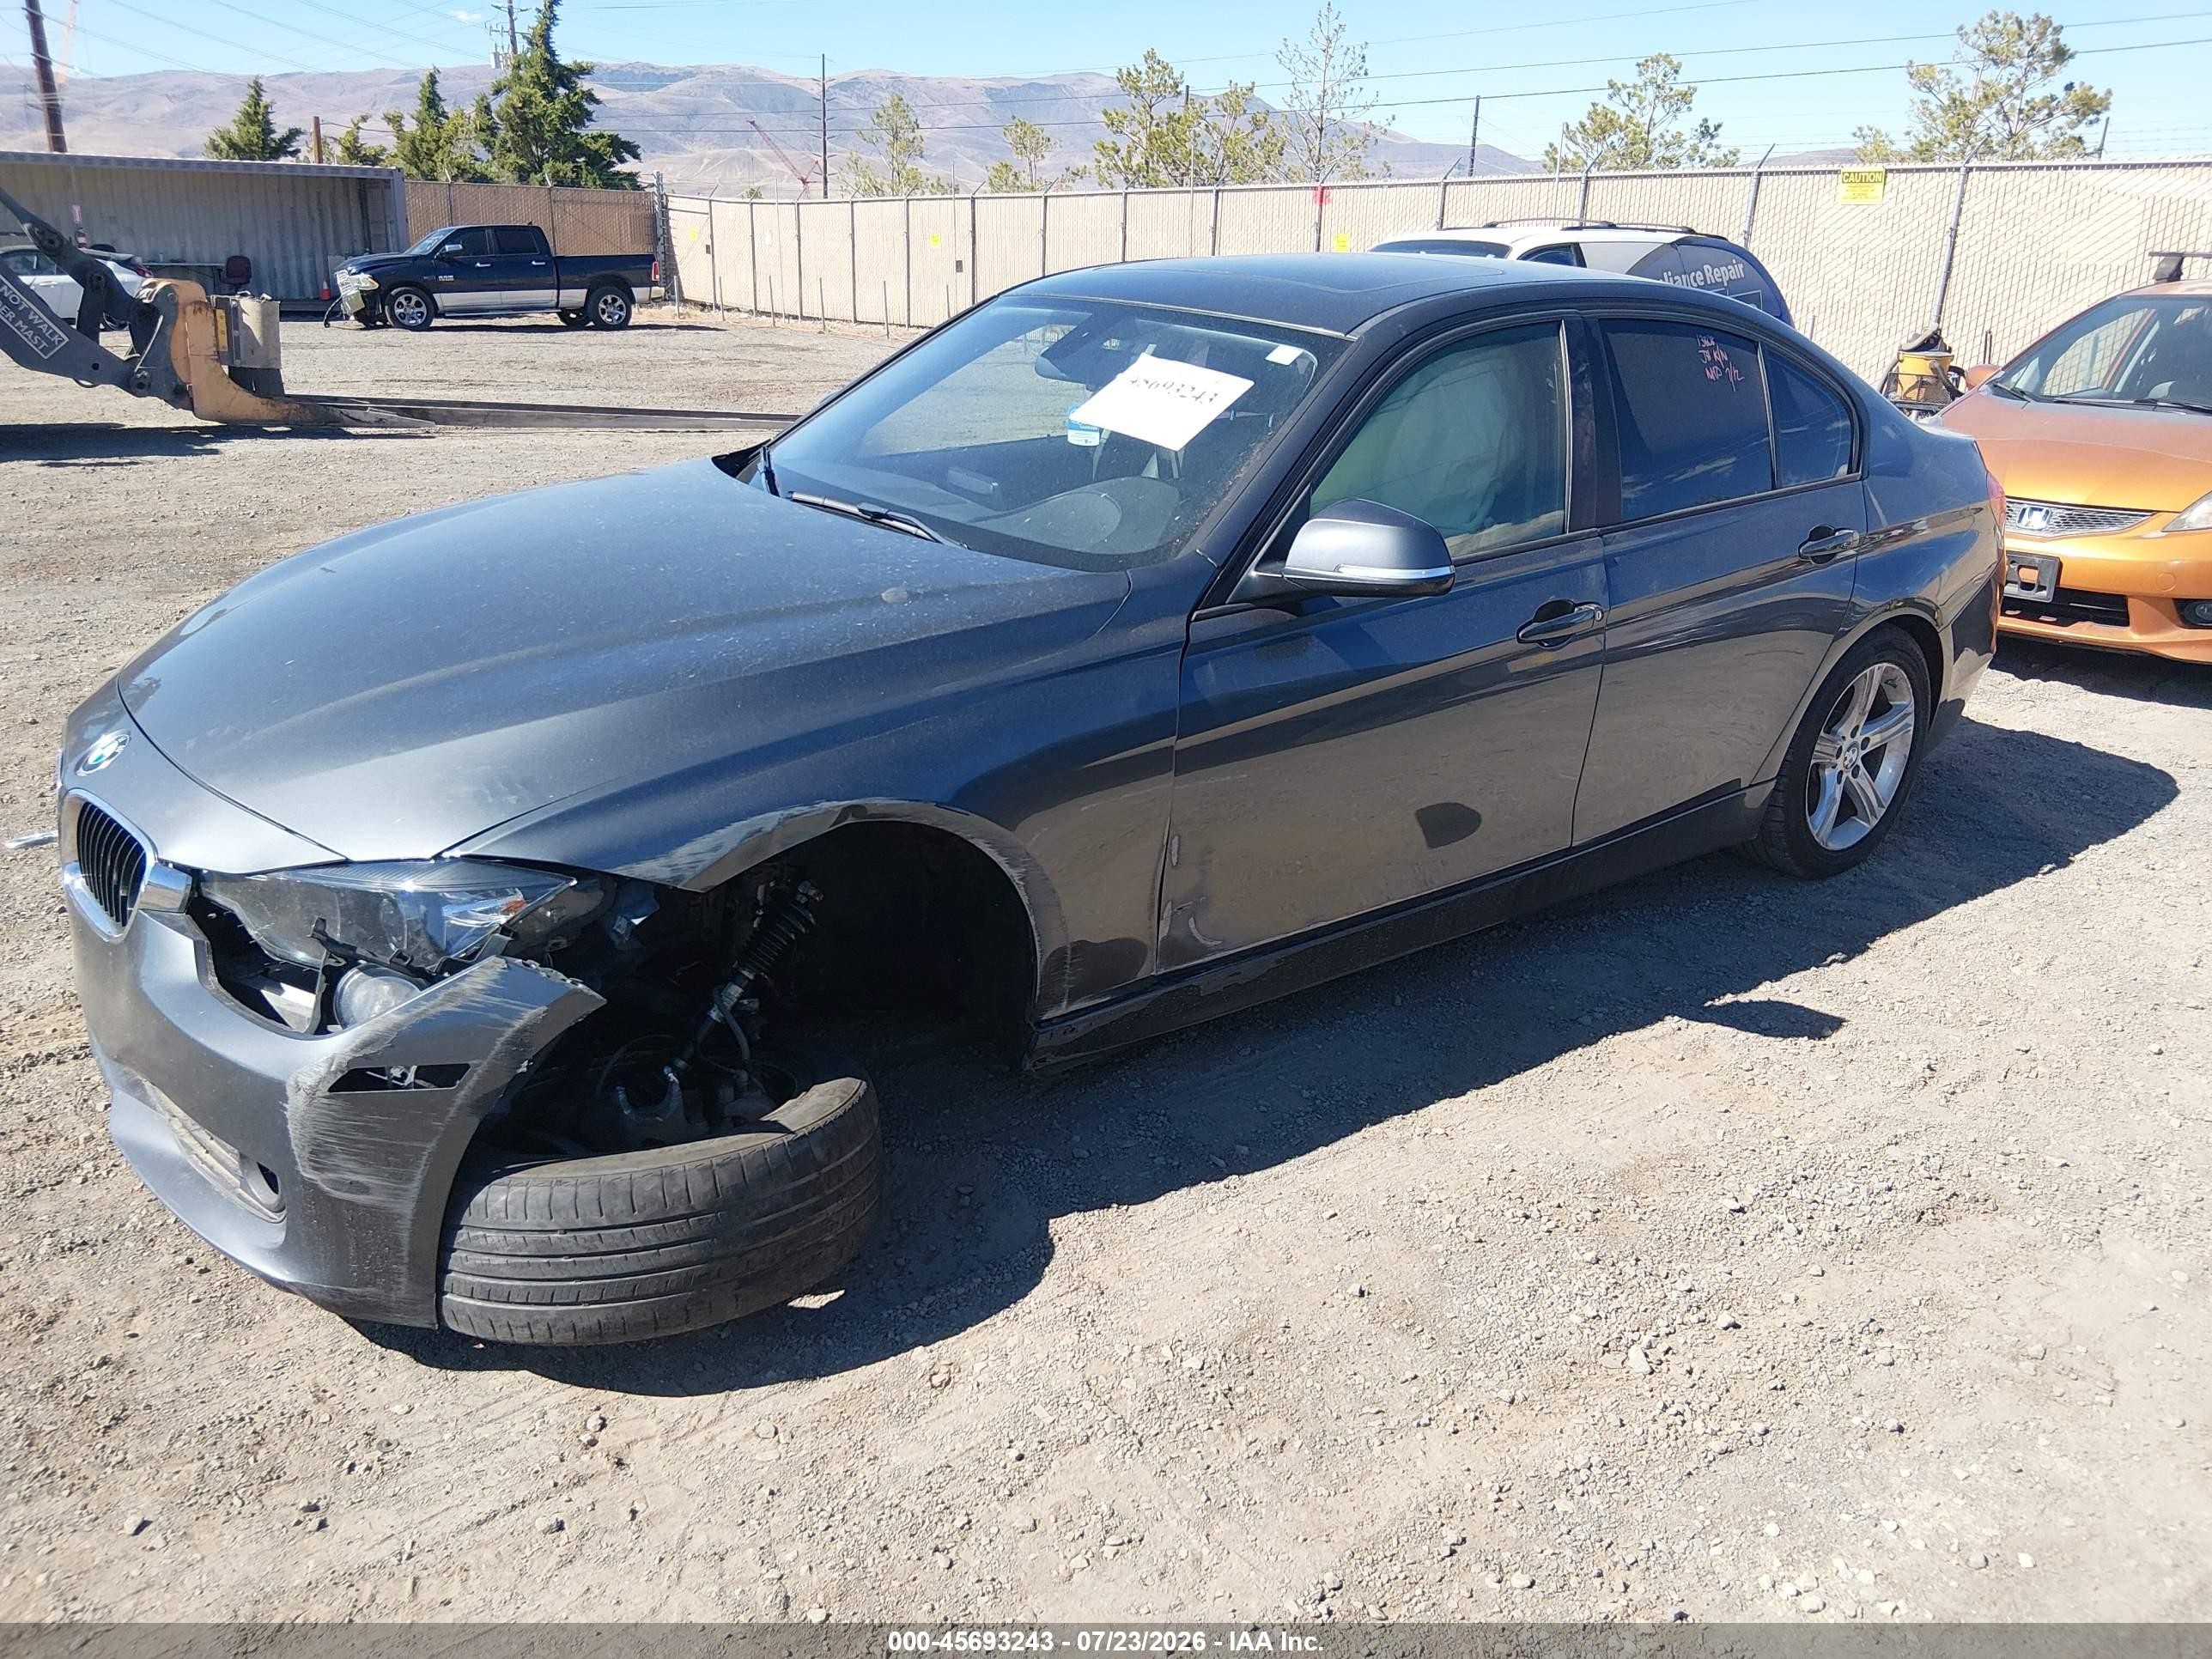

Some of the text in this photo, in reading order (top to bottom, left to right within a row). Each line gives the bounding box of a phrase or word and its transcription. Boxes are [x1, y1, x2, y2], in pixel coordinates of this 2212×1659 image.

[1843, 172, 1882, 183] CAUTION
[1659, 259, 1745, 288] liance Repair
[0, 285, 64, 345] NOT WALK
[15, 320, 49, 349] MAST
